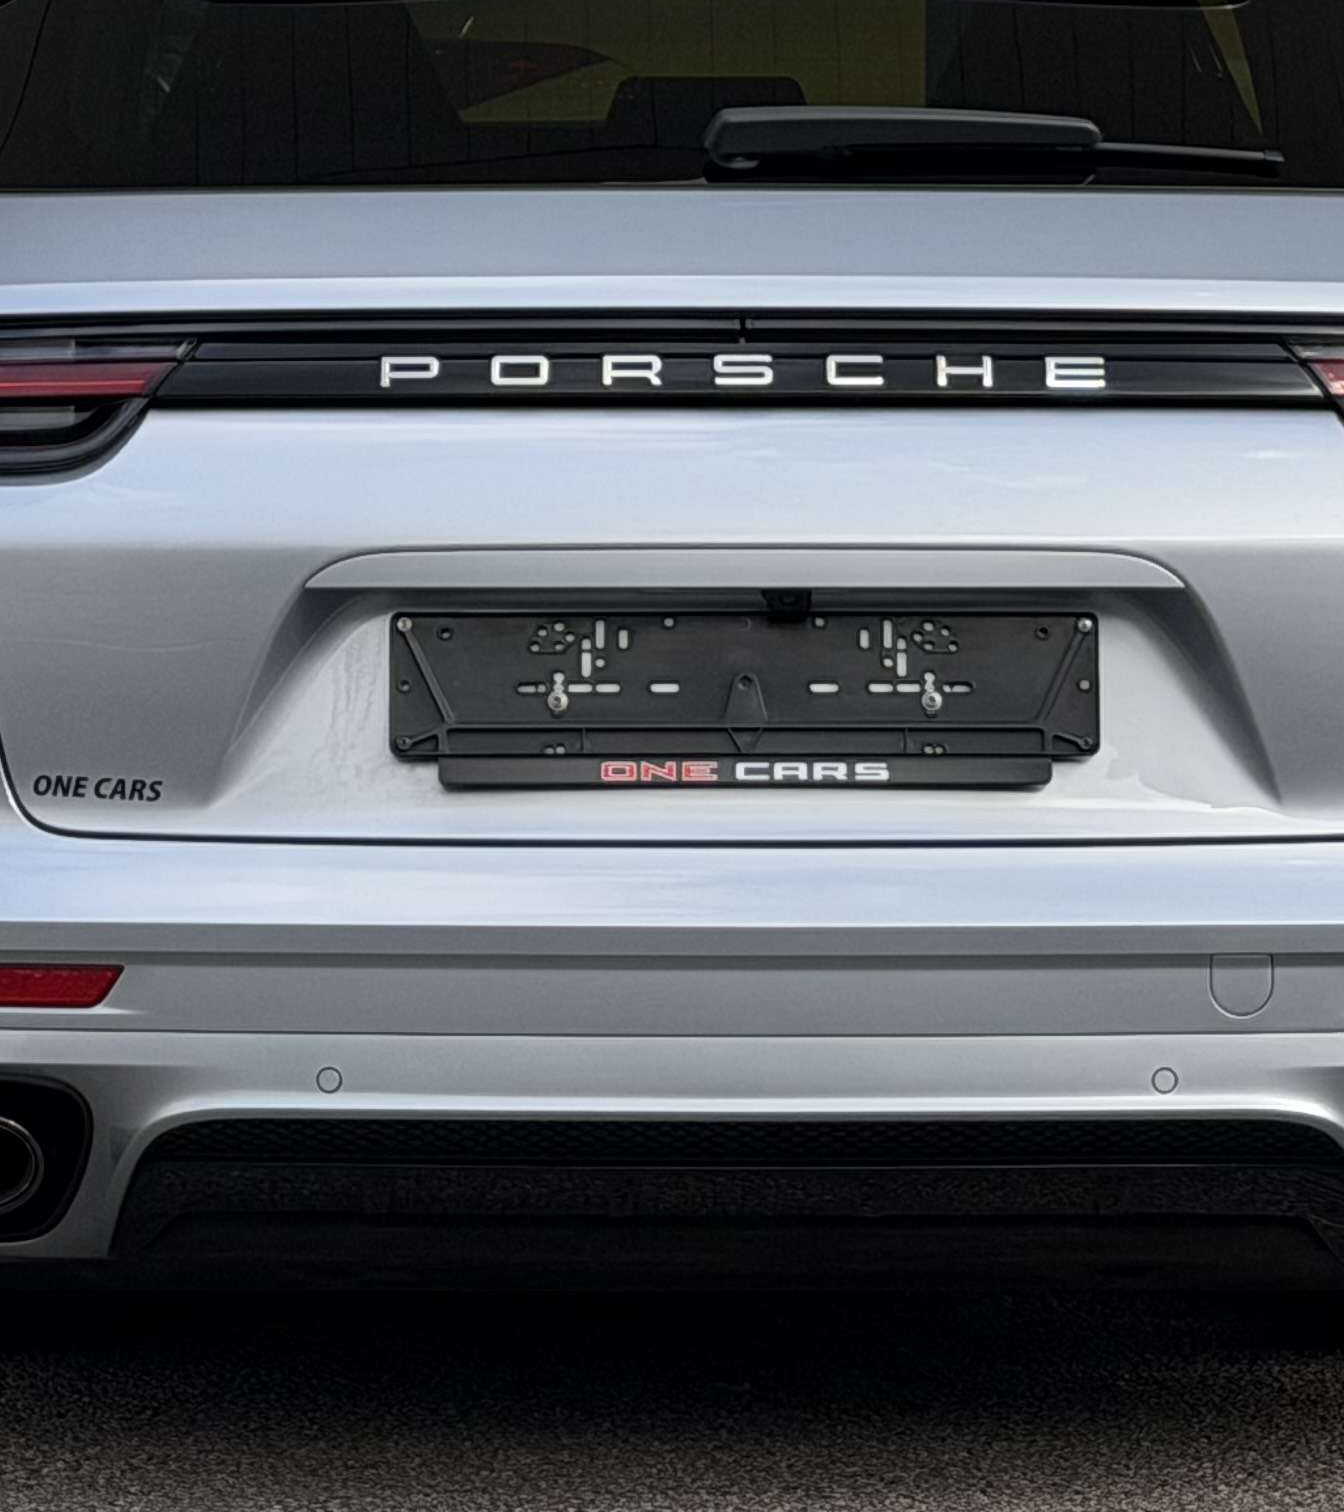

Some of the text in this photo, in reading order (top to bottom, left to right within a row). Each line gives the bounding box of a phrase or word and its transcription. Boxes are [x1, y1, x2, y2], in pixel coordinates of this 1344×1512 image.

[379, 354, 1106, 389] PORSCHE
[600, 760, 890, 782] ONE CARS
[33, 774, 163, 802] ONE CARS
